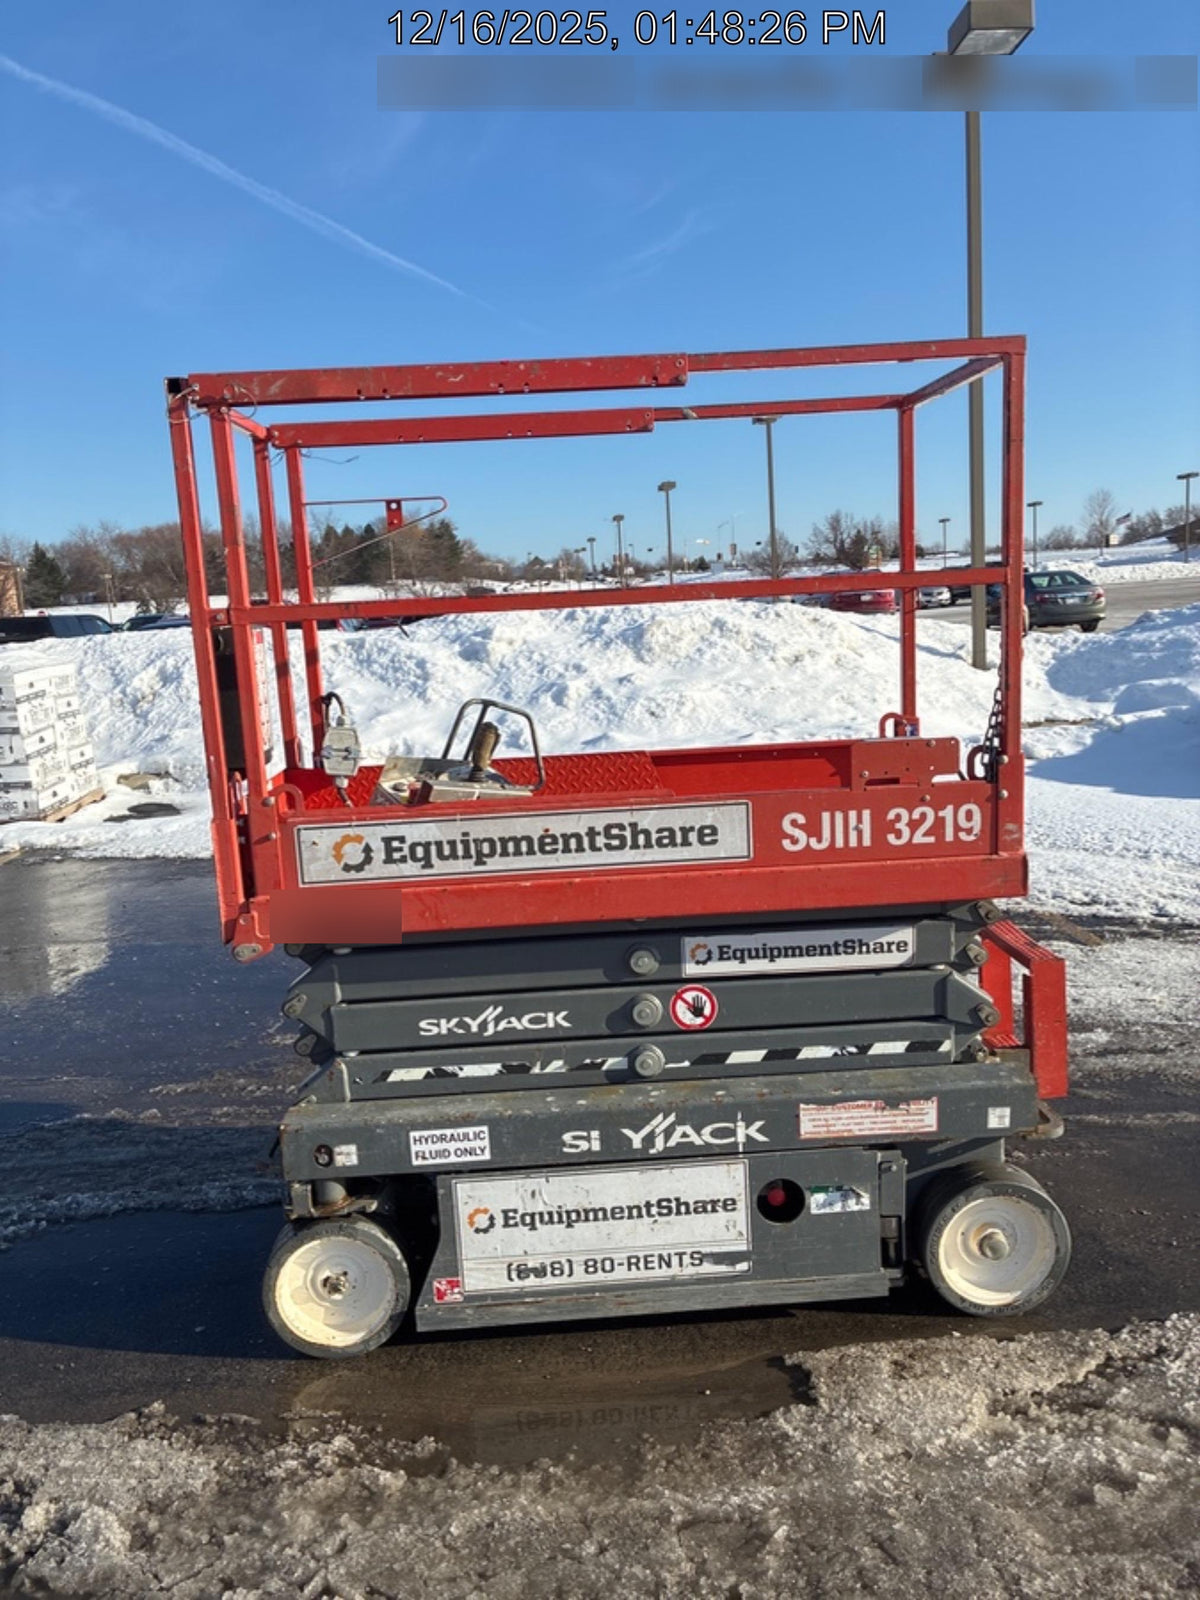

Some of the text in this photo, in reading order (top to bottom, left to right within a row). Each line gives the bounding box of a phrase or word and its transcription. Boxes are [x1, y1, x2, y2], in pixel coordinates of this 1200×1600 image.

[886, 803, 982, 846] 3219
[381, 822, 719, 870] EquipmentShare
[717, 937, 909, 964] EquipmentShare
[418, 1005, 572, 1036] SKYJACK
[412, 1130, 486, 1145] HYDRAULIC
[414, 1145, 487, 1161] FLUID ONLY
[501, 1197, 738, 1232] EquipmentShare
[583, 1250, 704, 1275] 80-RENTS
